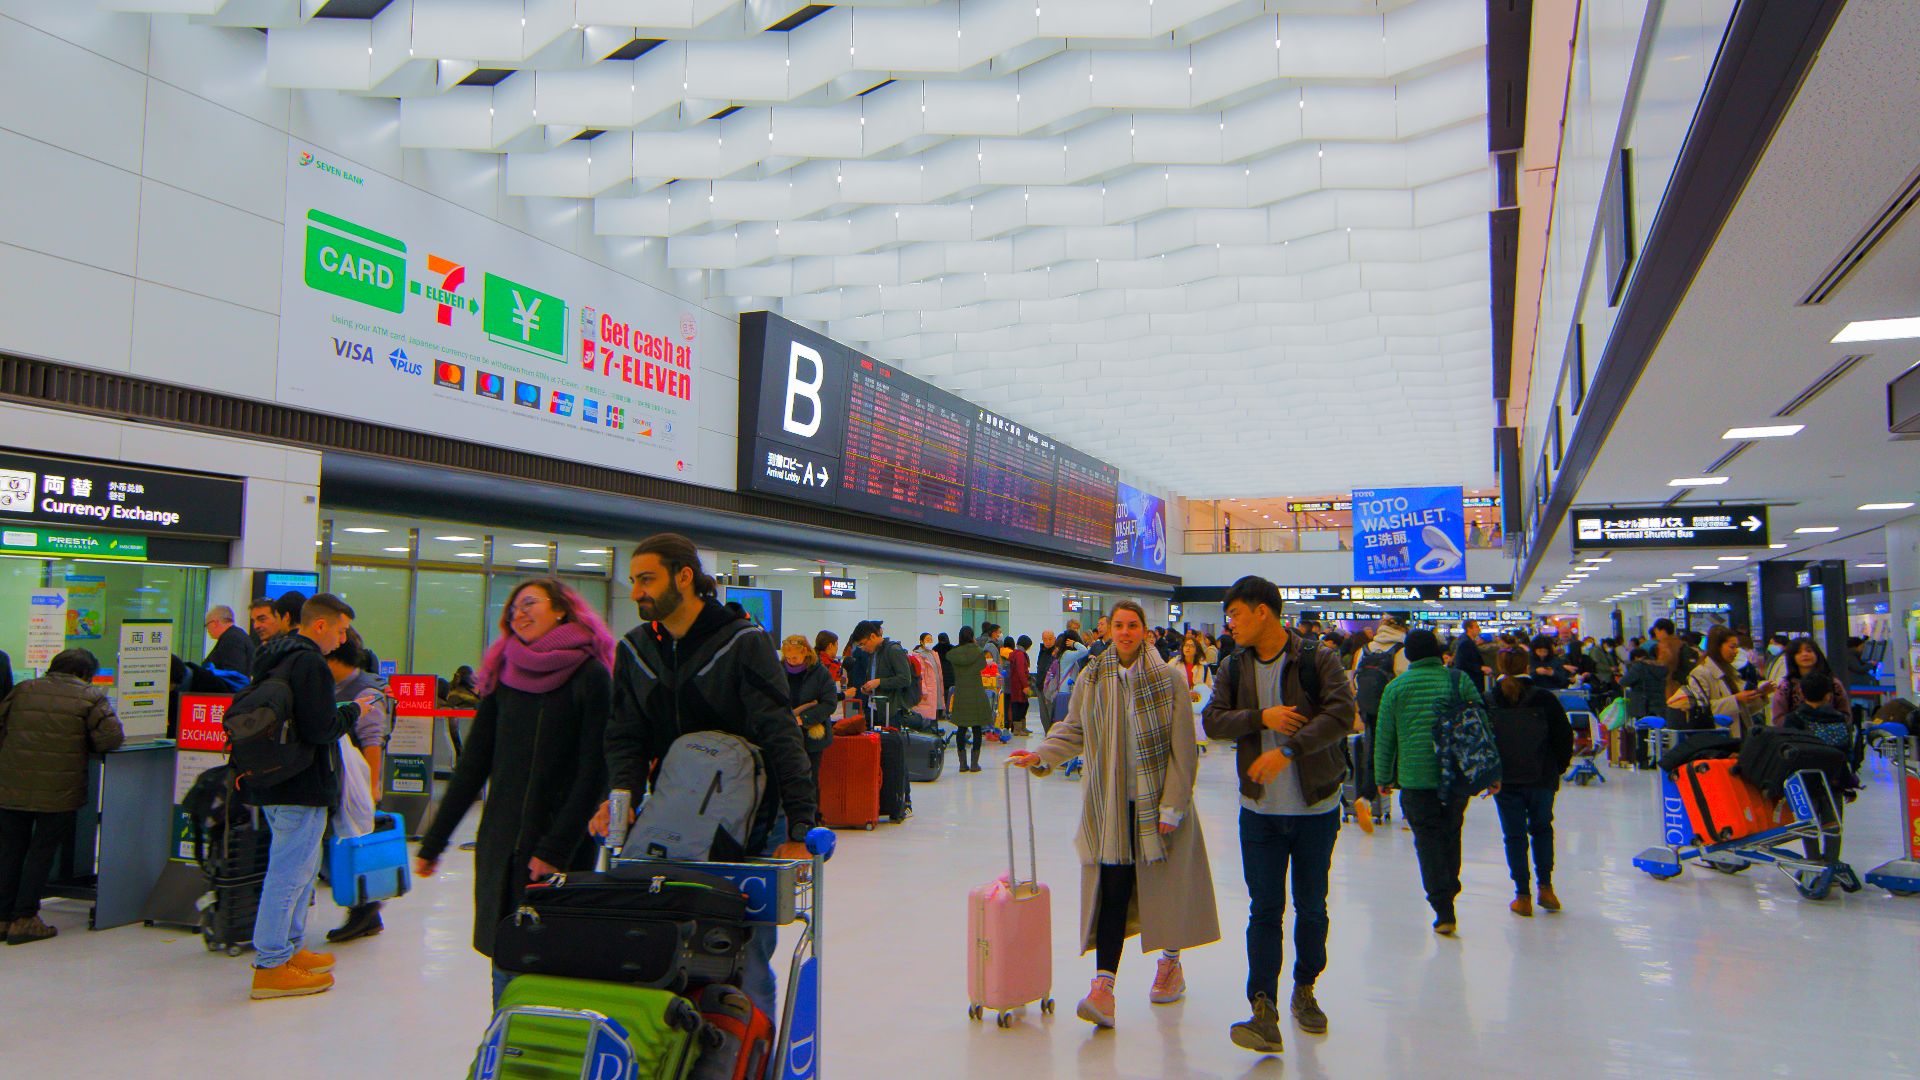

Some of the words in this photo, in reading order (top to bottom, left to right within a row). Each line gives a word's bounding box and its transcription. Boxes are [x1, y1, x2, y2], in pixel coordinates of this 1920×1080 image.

[316, 160, 341, 176] SEVEN
[343, 170, 364, 186] BANK
[320, 246, 394, 289] CARD
[331, 314, 353, 329] Using
[354, 321, 370, 332] your
[372, 326, 388, 336] ATM
[409, 336, 439, 351] Japanese
[441, 346, 468, 360] currency
[601, 313, 630, 350] Get
[634, 330, 673, 364] cash
[676, 344, 691, 371] at
[331, 336, 375, 365] VISA
[397, 359, 423, 377] PLUS
[783, 340, 824, 438] B
[766, 467, 785, 479] Arrival
[785, 470, 801, 485] Lobby
[803, 461, 814, 487] A
[43, 474, 93, 498] 両替
[42, 498, 110, 521] Currency
[111, 505, 180, 526] Exchange
[1358, 496, 1408, 516] TOTO
[1363, 530, 1407, 549] 卫洗丽
[1604, 530, 1643, 540] Terminal
[1644, 529, 1677, 539] Shuttle
[1677, 529, 1695, 539] Bus
[1409, 587, 1421, 599] A
[1355, 612, 1370, 620] Train
[131, 631, 163, 644] 両替
[400, 682, 426, 696] 両替
[192, 703, 225, 724] 両替
[396, 700, 433, 710] XCHANGE
[181, 728, 227, 743] EXCHANG
[1664, 797, 1684, 844] DHC
